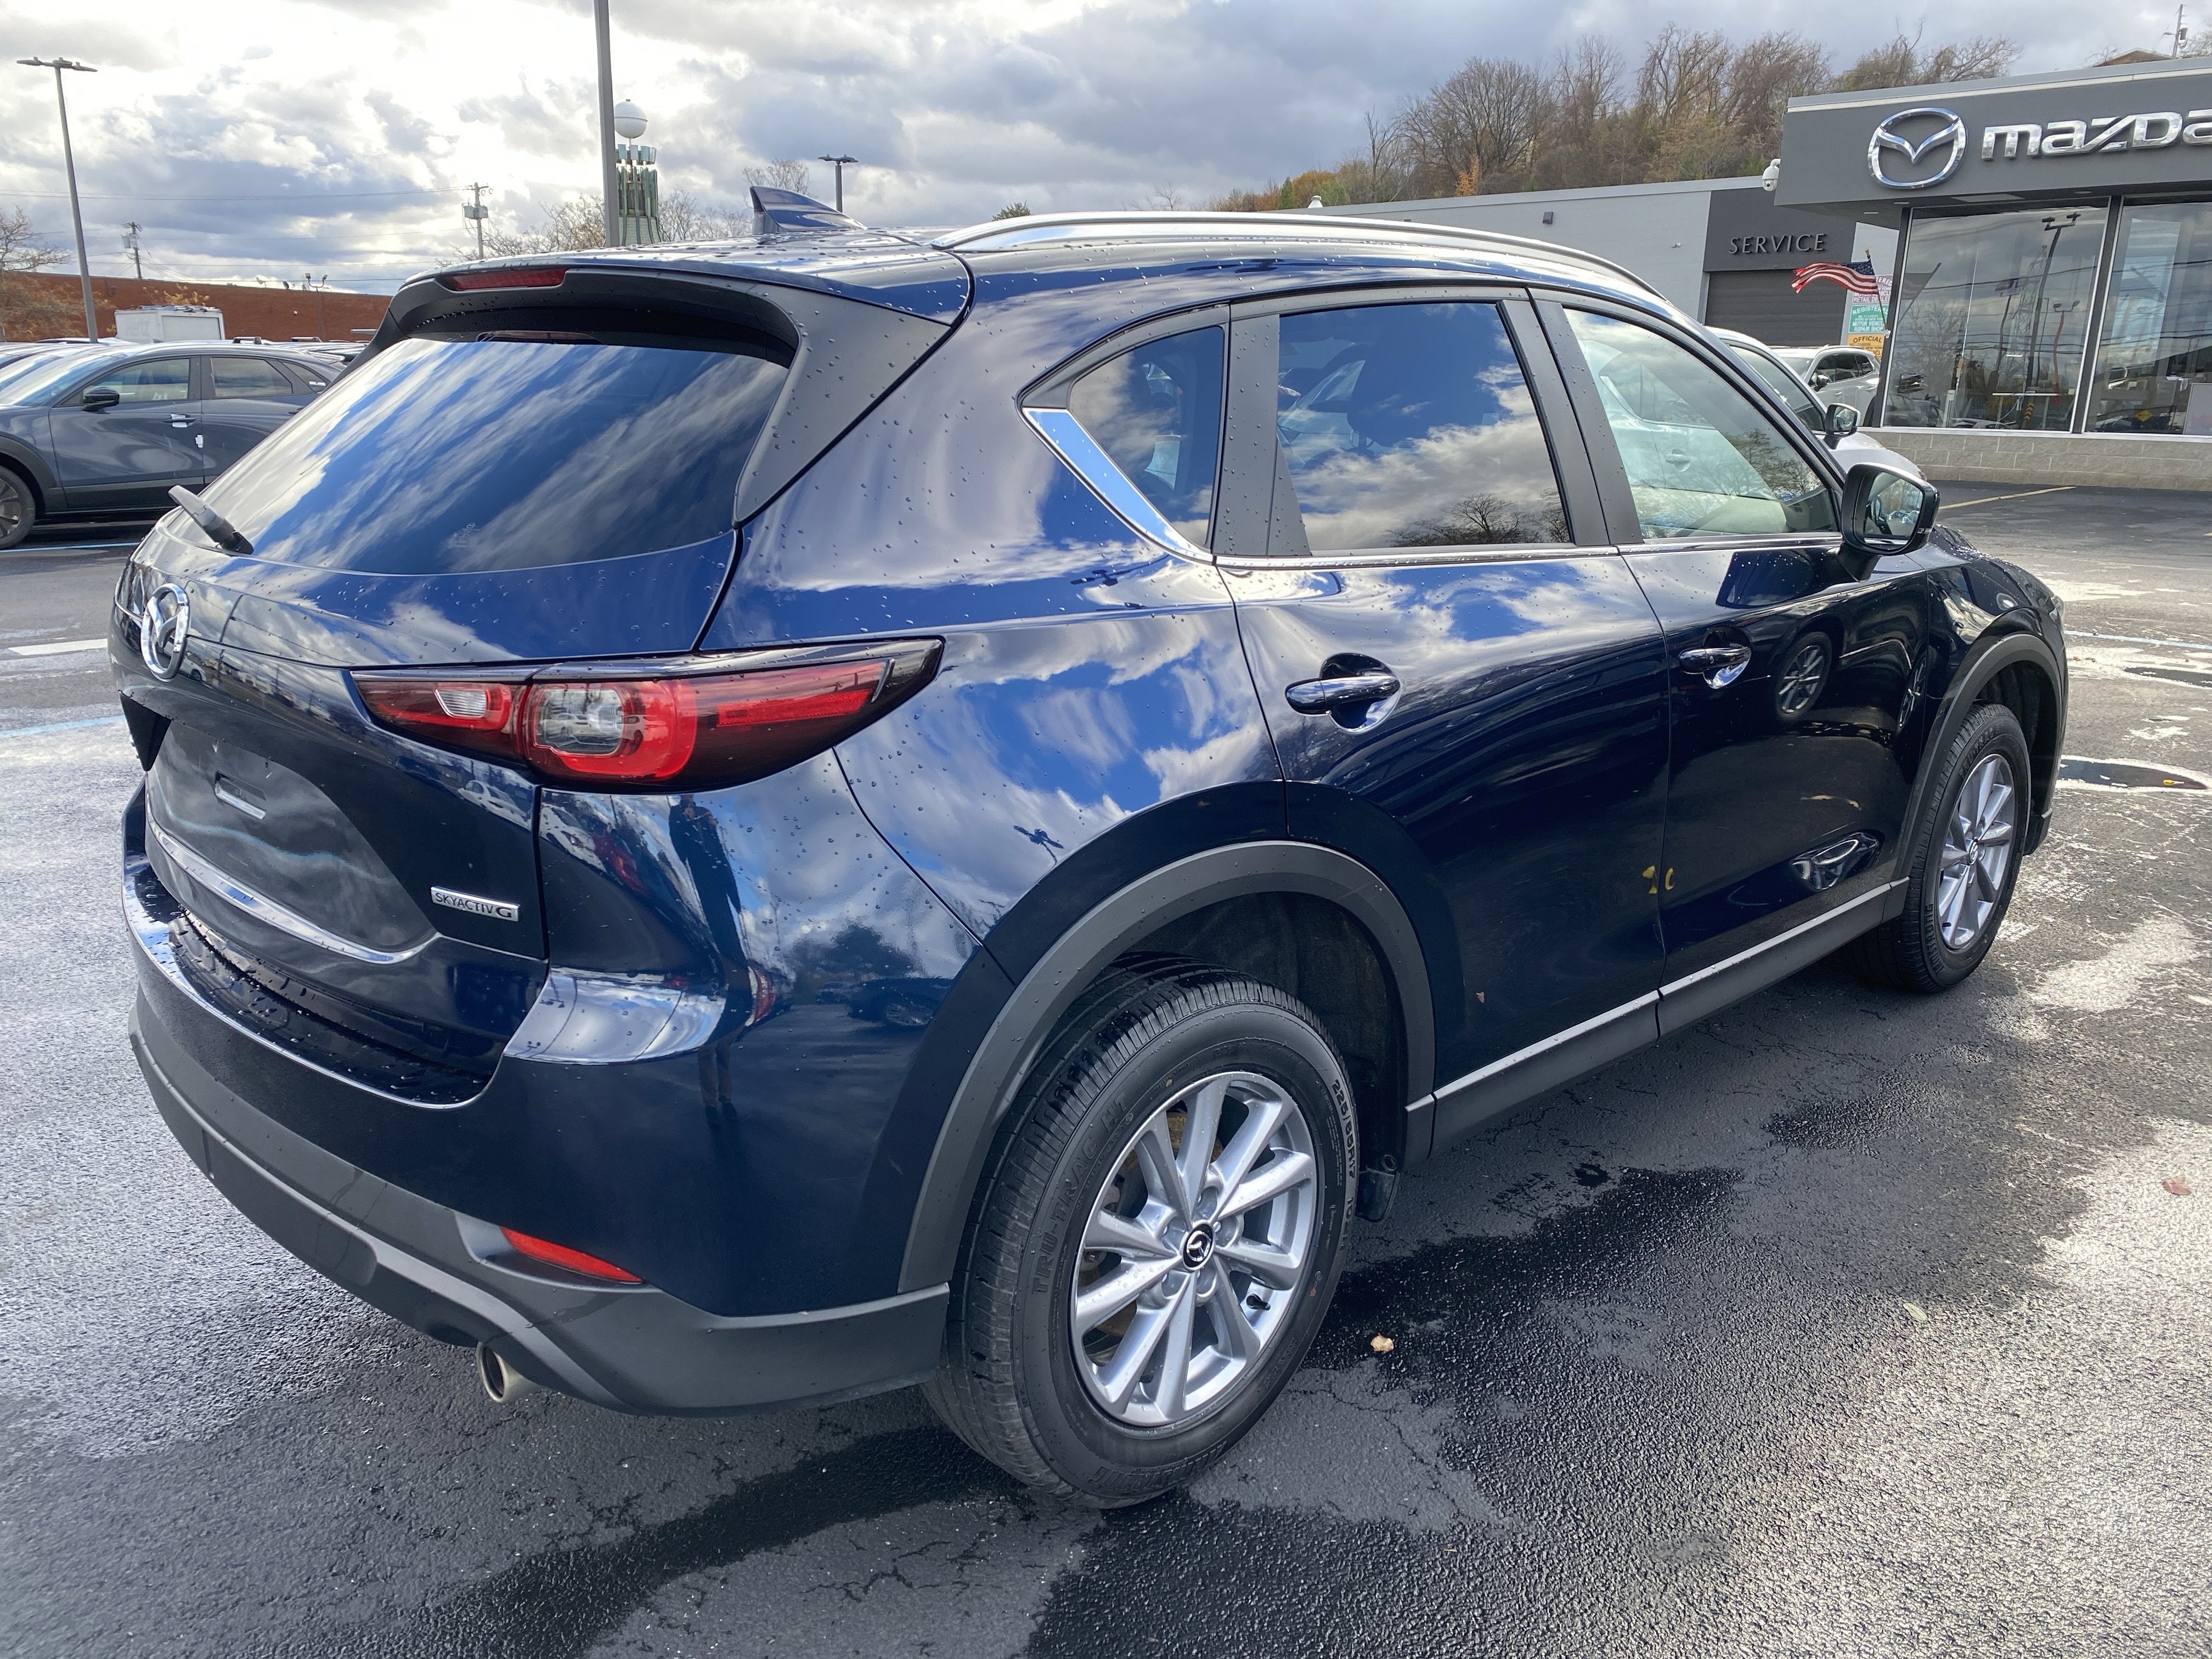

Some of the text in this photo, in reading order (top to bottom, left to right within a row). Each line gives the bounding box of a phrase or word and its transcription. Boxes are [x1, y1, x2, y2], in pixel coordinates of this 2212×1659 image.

[1728, 233, 1826, 254] SERVICE
[435, 892, 493, 914] SKYACTIV
[1331, 1079, 1356, 1178] 225/65R17
[1031, 1136, 1099, 1296] TRU-TRAC
[1101, 1090, 1129, 1132] HT
